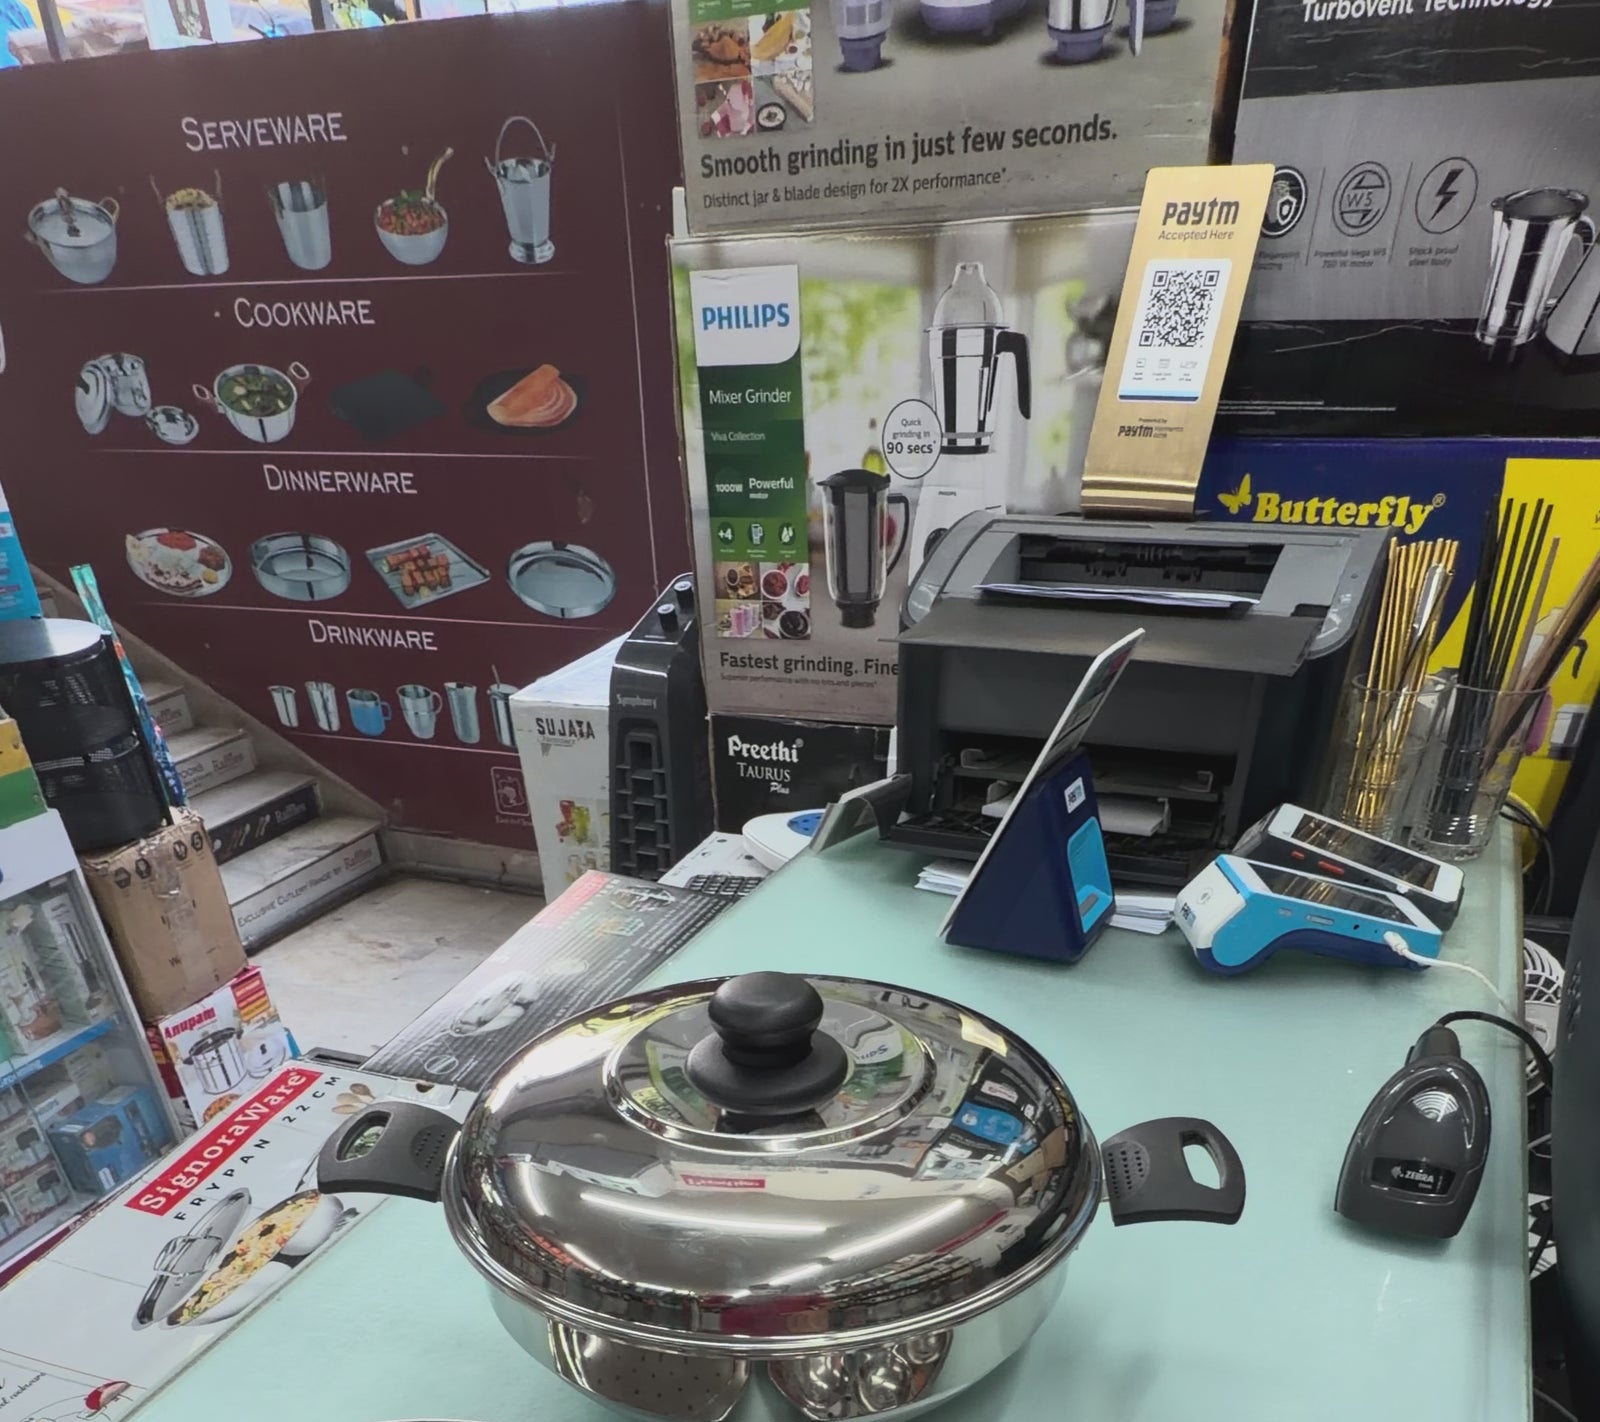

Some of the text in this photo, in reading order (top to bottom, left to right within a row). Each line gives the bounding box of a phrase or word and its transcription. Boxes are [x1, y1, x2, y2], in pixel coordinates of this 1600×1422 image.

[181, 112, 348, 151] SERVEWARE
[700, 113, 1118, 179] Smooth grinding in just few seconds.
[703, 191, 750, 209] Distinct
[752, 190, 770, 208] jar
[772, 187, 781, 202] &
[784, 185, 820, 201] blade
[823, 180, 866, 200] design
[869, 178, 889, 194] for
[891, 176, 909, 193] 2X
[1158, 230, 1235, 242] Accepted Here
[234, 297, 376, 328] COOKWARE
[701, 302, 791, 331] PHILIPS
[708, 386, 792, 405] Mixer Grinder
[711, 430, 766, 442] Viva Collection
[886, 441, 904, 455] 90
[262, 464, 418, 495] DINNERWARE
[748, 477, 794, 490] Powerful
[1251, 490, 1435, 534] Butterfly
[307, 619, 438, 650] DRINKWARE
[719, 652, 899, 677] Fastest grinding. Fine
[535, 717, 596, 740] SUJATA
[727, 735, 800, 763] Preethi
[736, 762, 792, 782] TAURUS
[164, 1007, 217, 1039] Anupam
[1405, 1170, 1435, 1183] ZEBRA
